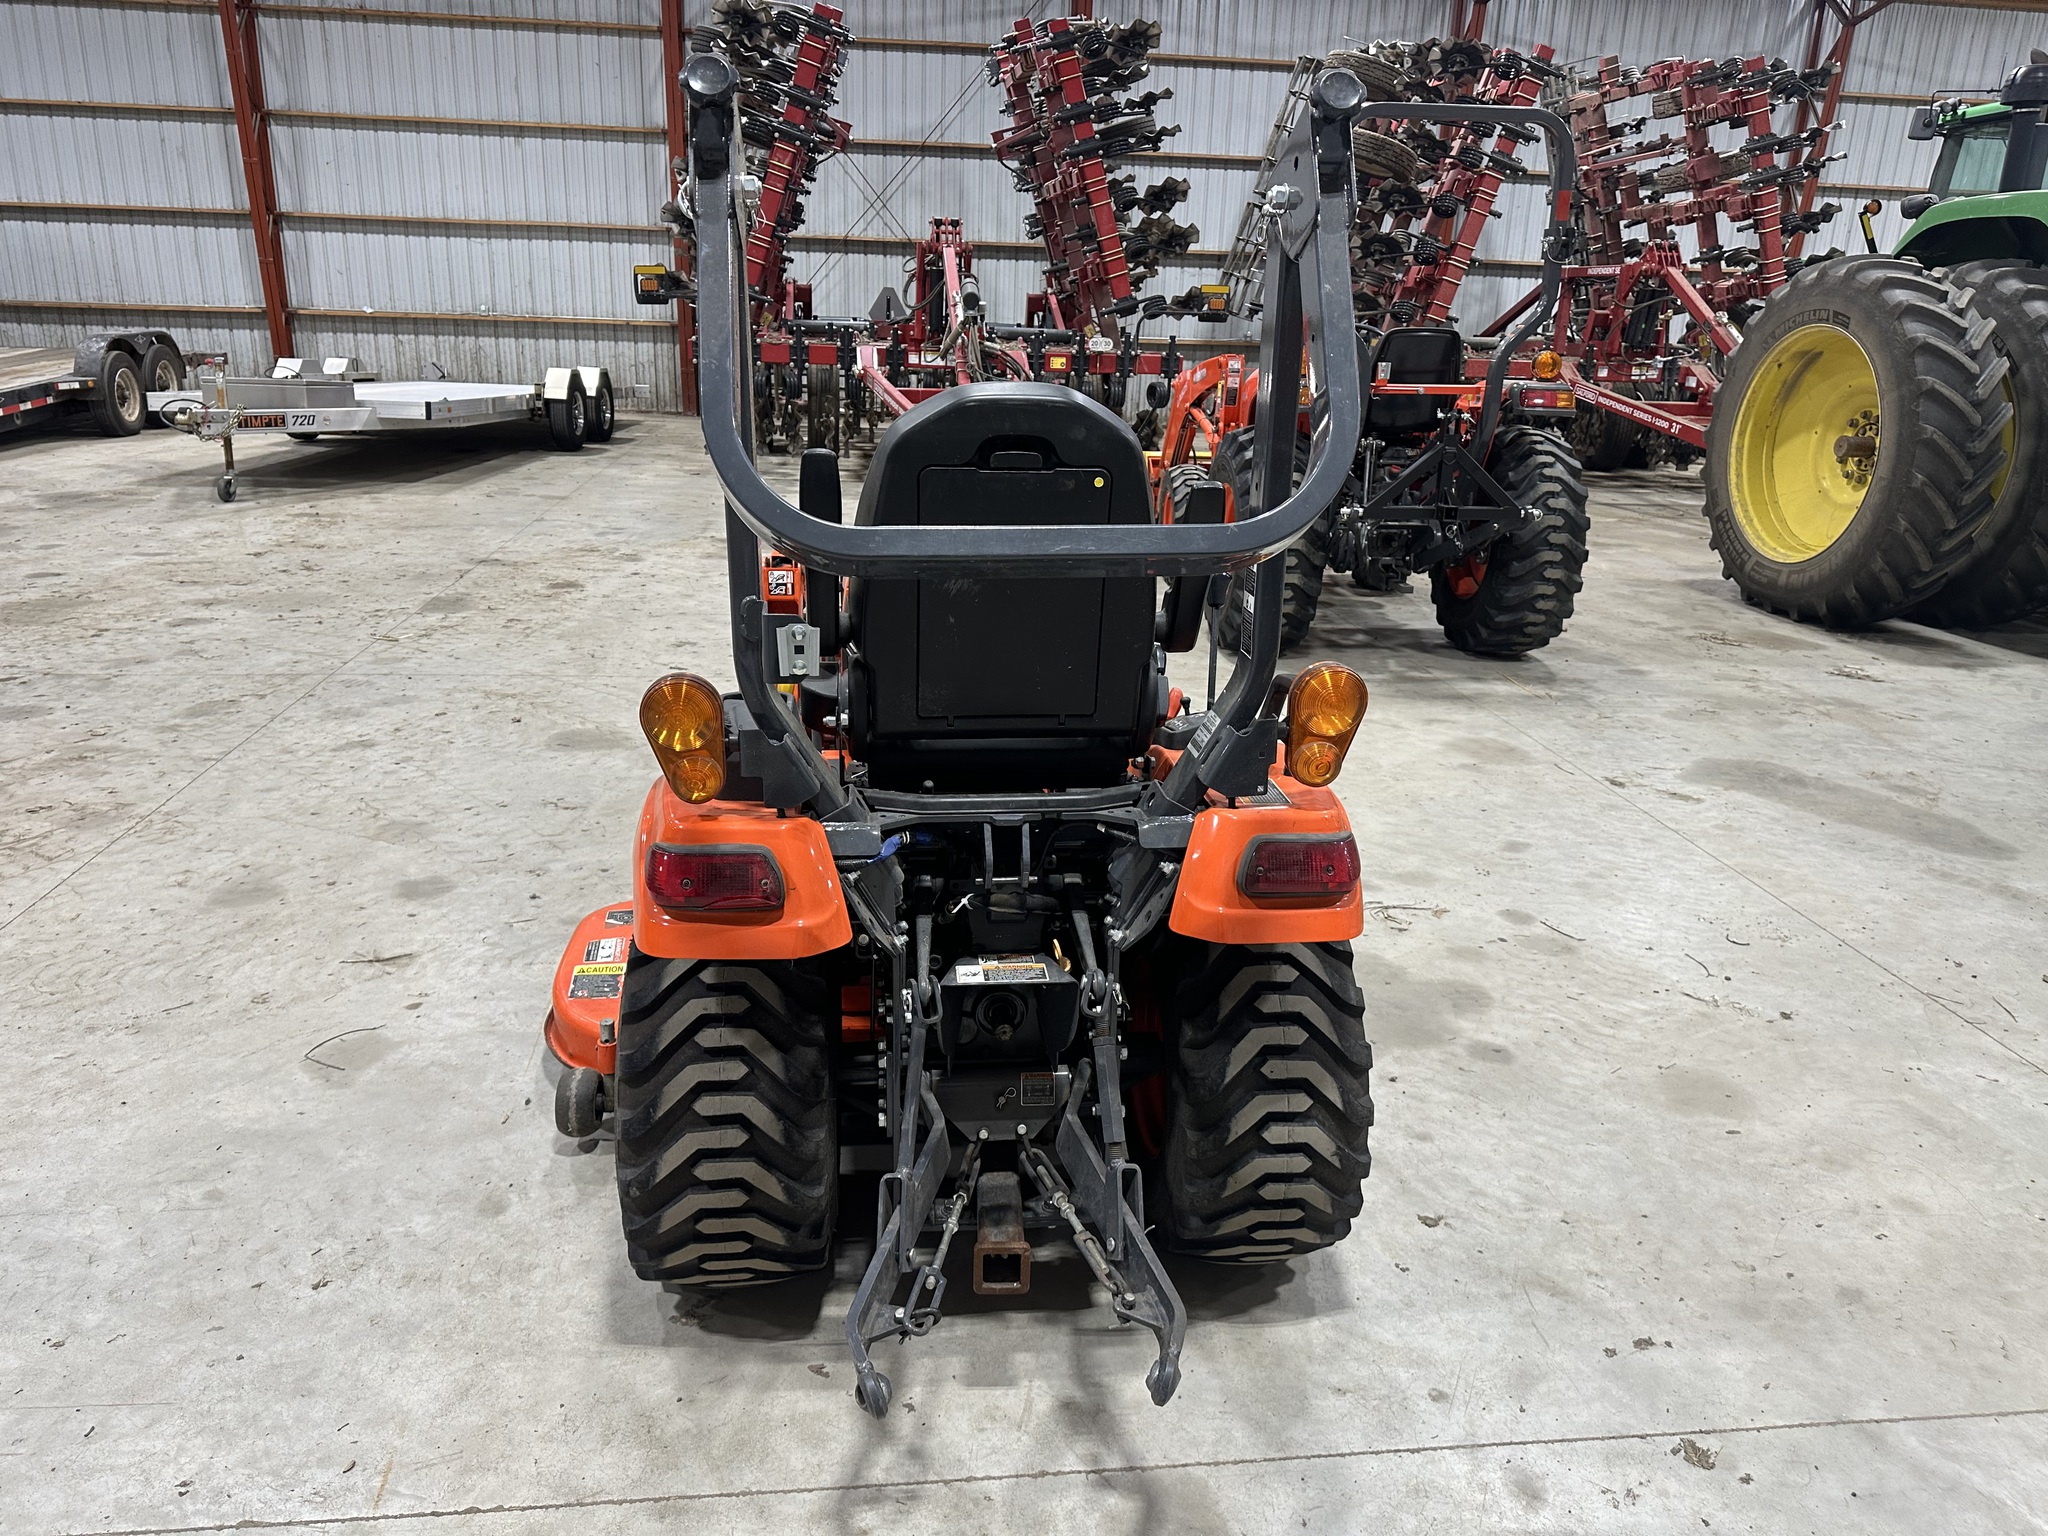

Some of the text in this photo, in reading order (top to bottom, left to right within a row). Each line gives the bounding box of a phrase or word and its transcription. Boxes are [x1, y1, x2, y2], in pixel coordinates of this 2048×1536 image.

[1775, 309, 1829, 338] MICHELIN
[1597, 396, 1633, 414] INDEPENDENT
[1633, 408, 1651, 422] SERIES
[240, 414, 315, 427] TIMPTE 720
[586, 965, 624, 974] CAUTION
